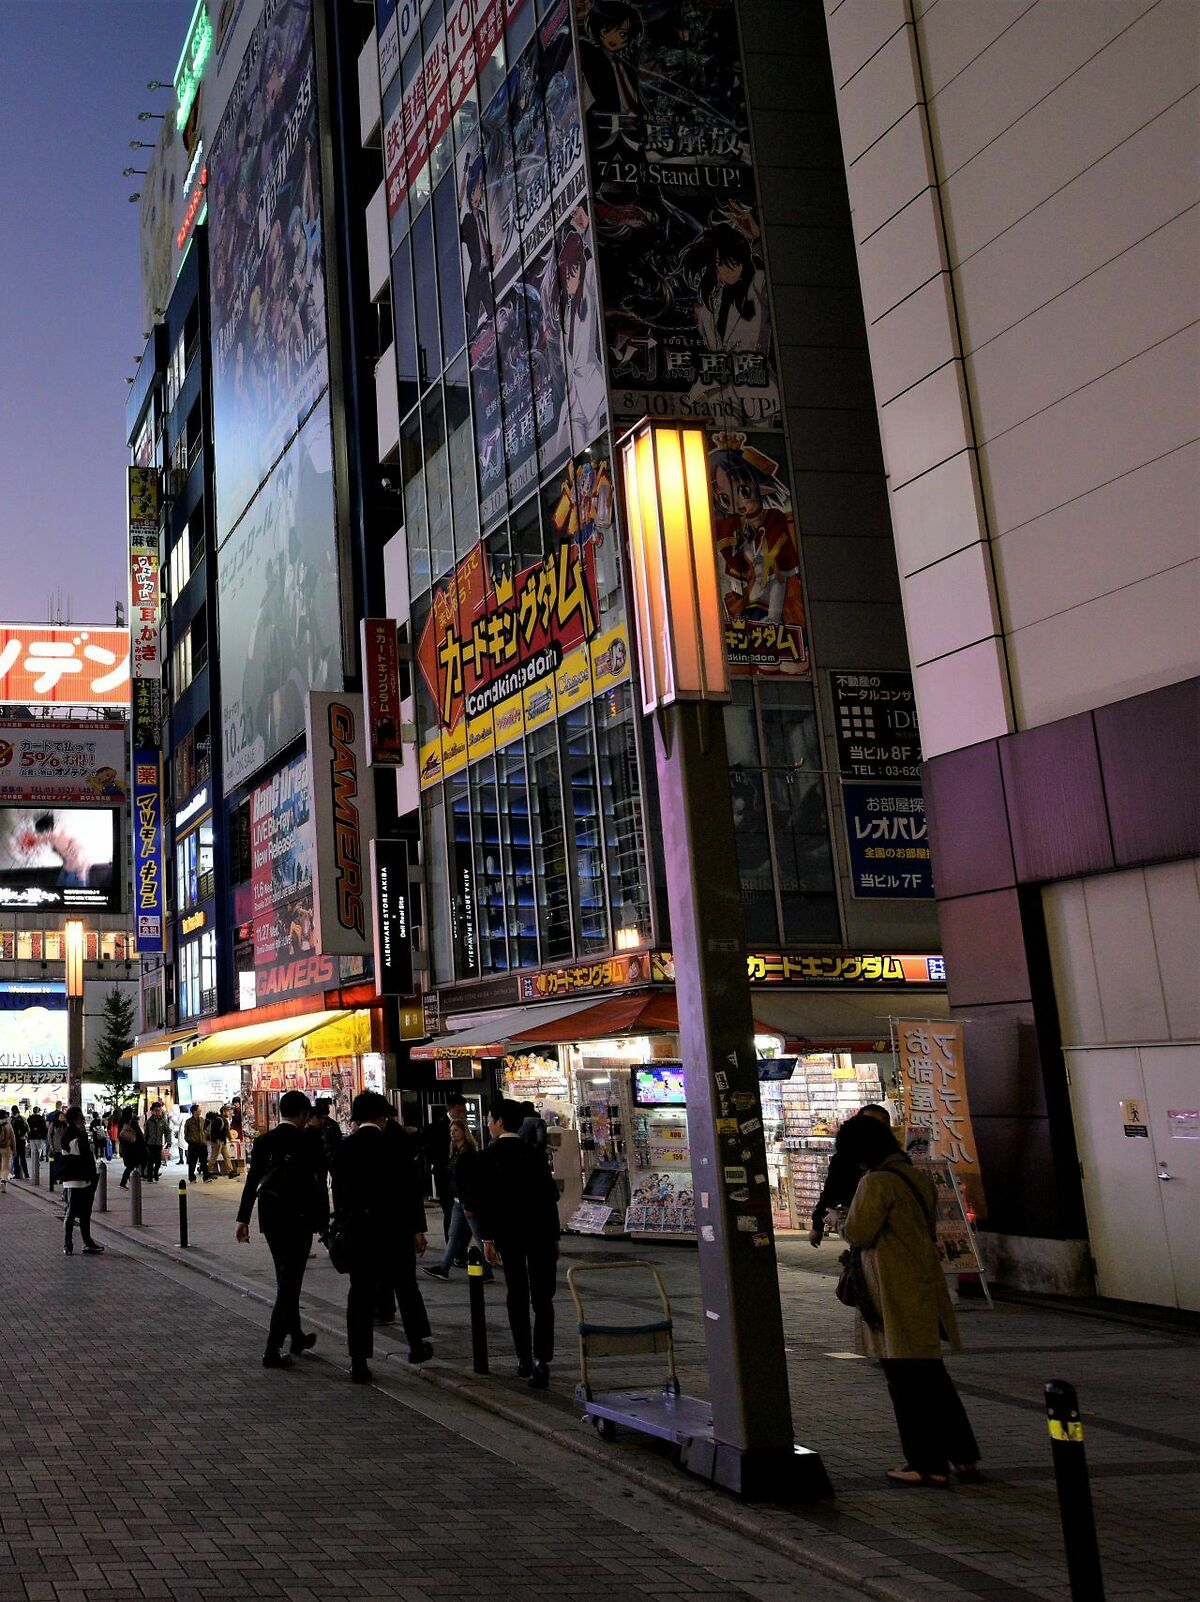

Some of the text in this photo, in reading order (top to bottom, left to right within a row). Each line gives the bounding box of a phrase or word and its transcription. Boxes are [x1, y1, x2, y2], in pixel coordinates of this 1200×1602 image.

[593, 111, 744, 156] 天馬解放
[649, 164, 699, 186] Stand
[705, 167, 742, 188] UP!
[609, 334, 770, 388] 幻馬再臨
[680, 393, 734, 417] Stand
[741, 397, 778, 421] UP!
[132, 535, 157, 547] 麻雀
[140, 607, 158, 661] 耳かき
[440, 543, 595, 725] カードキングダム
[725, 624, 800, 661] キングダム
[726, 653, 776, 663] dkingdom
[836, 674, 881, 688] 不動産の
[838, 689, 913, 702] トータルコンサ
[20, 740, 97, 752] カードで払って
[850, 745, 911, 761] 当ビル 8F
[138, 765, 157, 785] 薬
[253, 823, 268, 846] LIVE
[328, 702, 366, 941] GAMERS
[854, 816, 928, 840] レオパレ
[137, 793, 158, 909] マツモトキヨシ
[254, 835, 295, 870] New Release
[860, 874, 922, 888] 当ビル 7F
[380, 866, 392, 967] ALIENWARE STORE AKIBA
[256, 957, 334, 998] GAMERS
[548, 961, 624, 994] カードキングダム
[747, 954, 905, 981] カードキングダム
